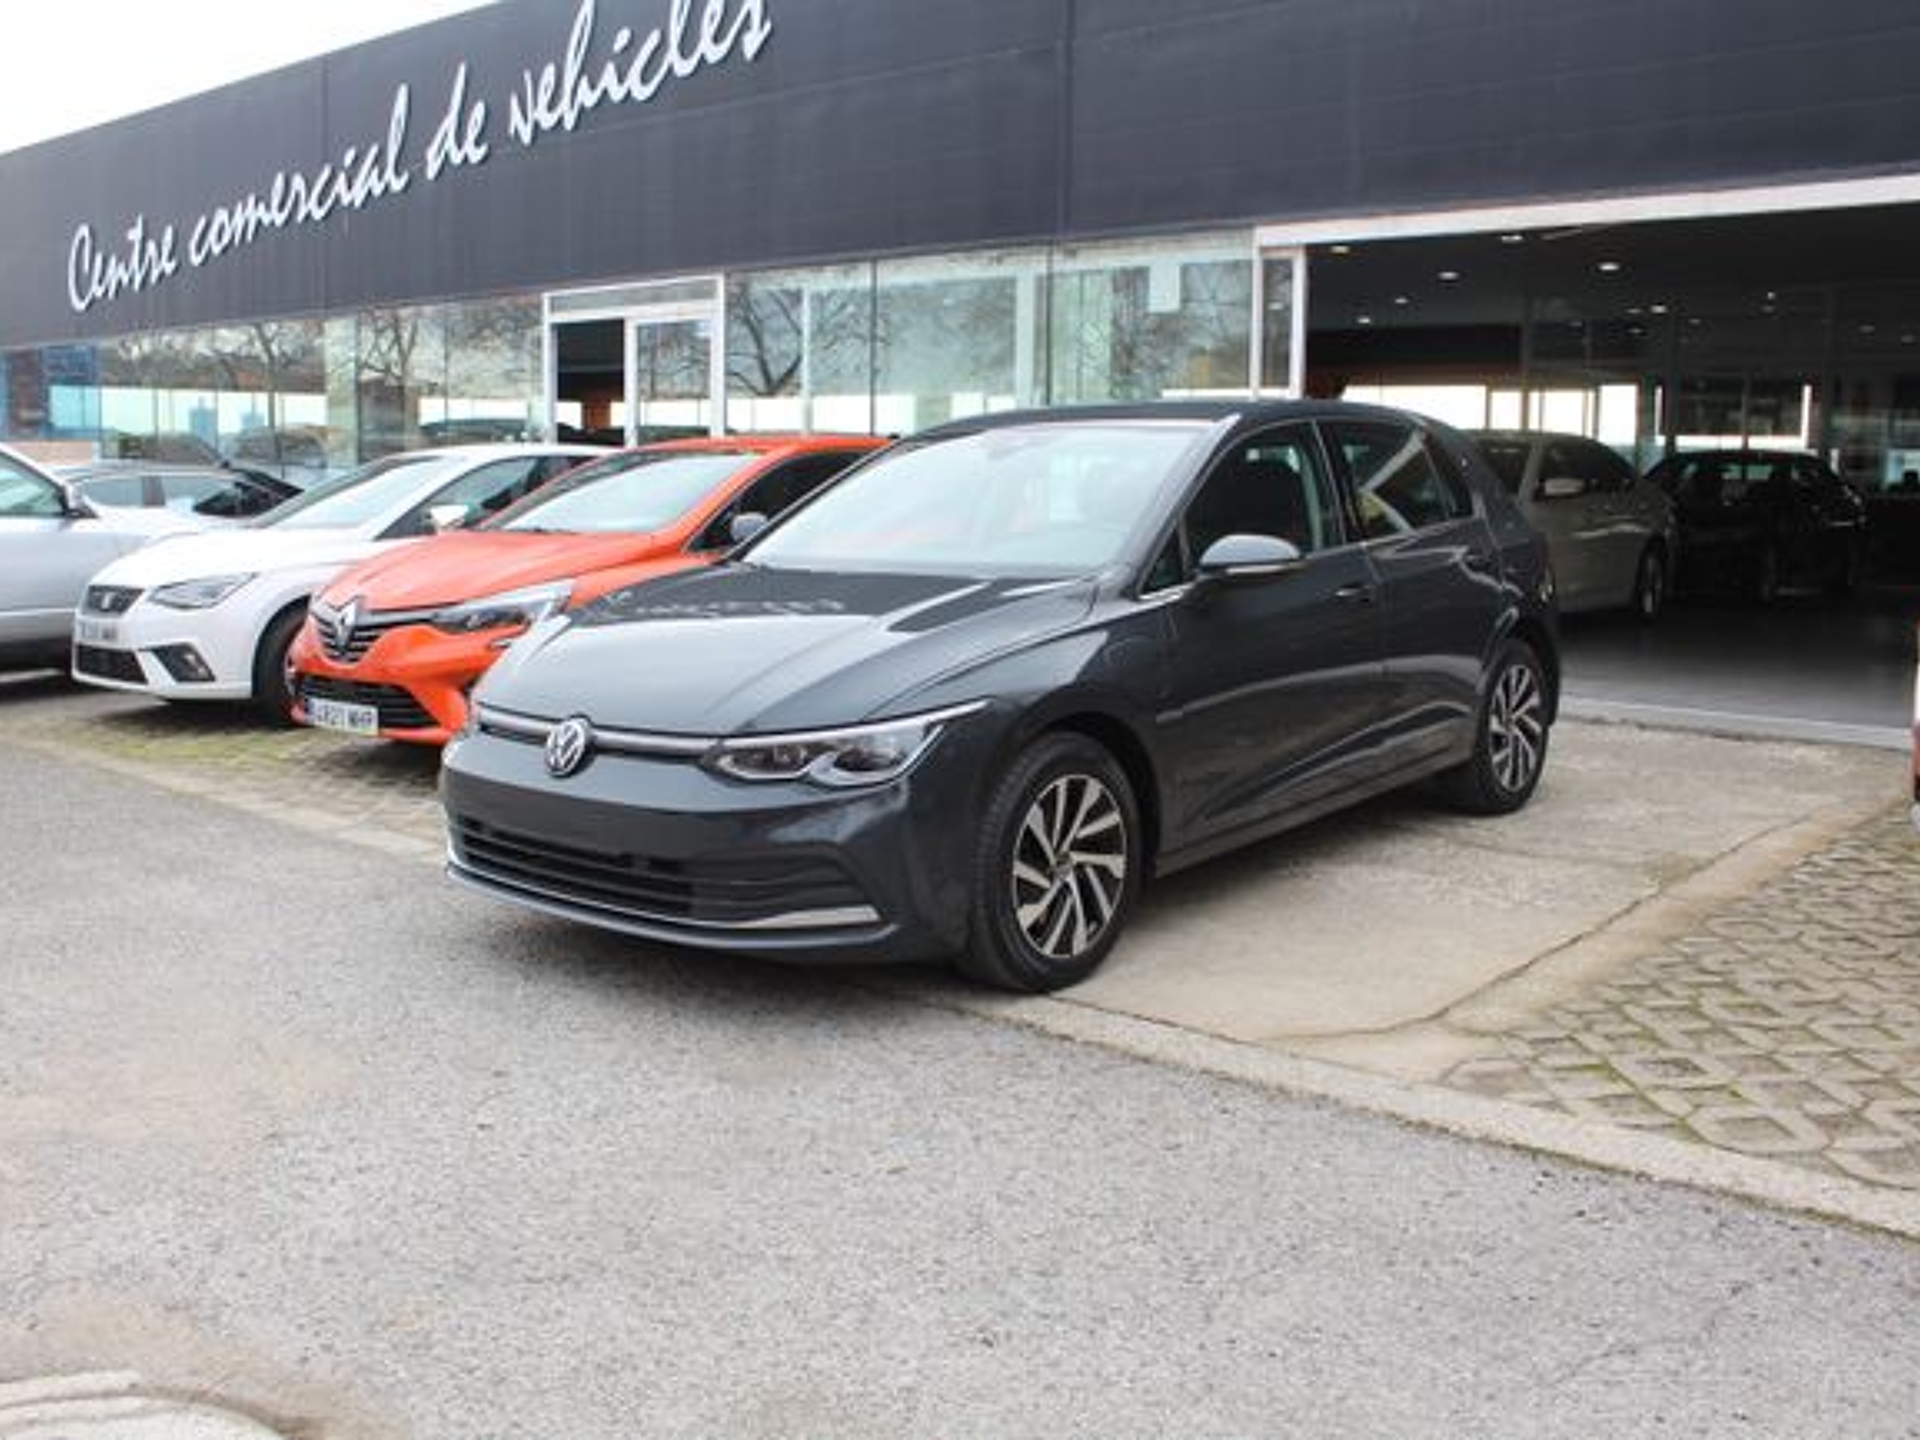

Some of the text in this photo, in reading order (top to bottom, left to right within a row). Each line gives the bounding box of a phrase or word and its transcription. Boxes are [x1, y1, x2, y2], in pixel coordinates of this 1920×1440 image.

[68, 0, 772, 311] Centre comercial de vehicles
